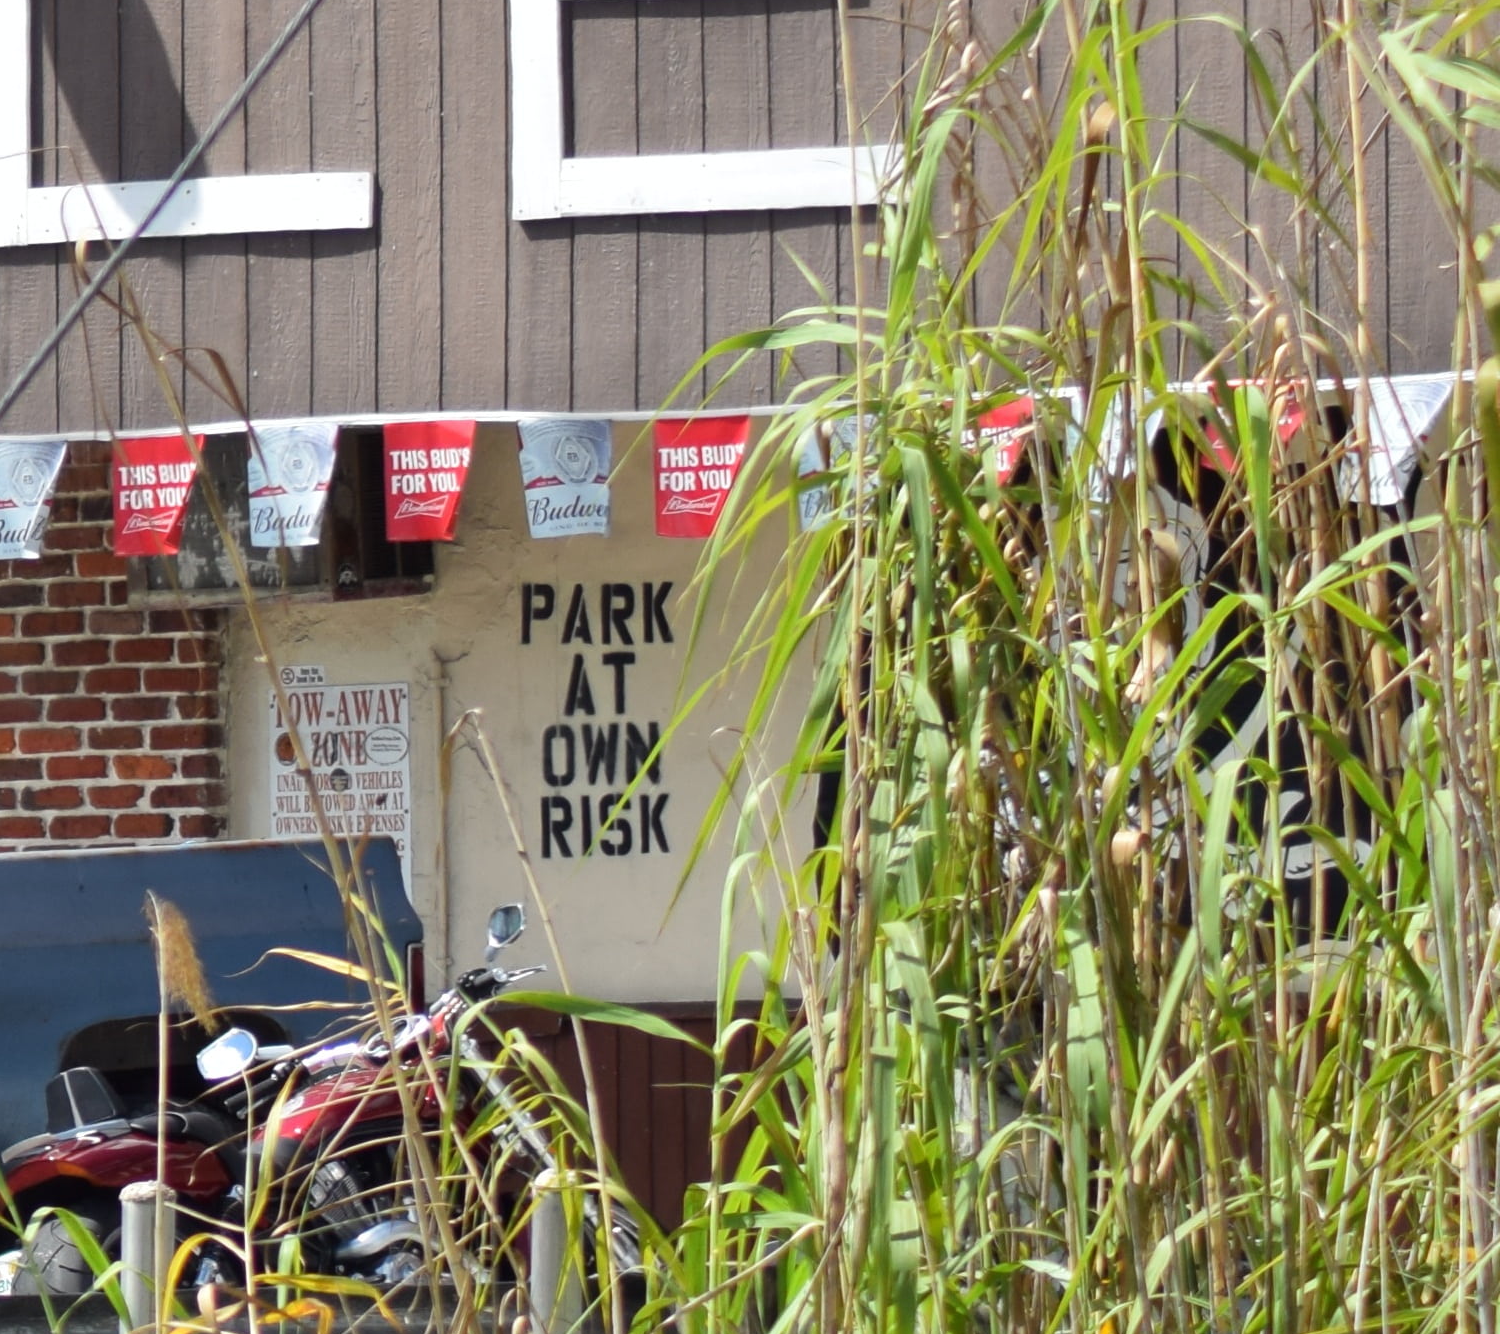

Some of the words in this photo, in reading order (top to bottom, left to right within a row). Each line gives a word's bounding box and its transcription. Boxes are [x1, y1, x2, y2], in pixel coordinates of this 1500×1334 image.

[390, 450, 428, 470] THIS
[430, 448, 470, 468] BUD'S
[658, 446, 699, 468] THIS
[118, 466, 156, 486] THIS
[391, 475, 426, 495] FOR
[428, 472, 460, 492] YOU.
[660, 471, 696, 492] FOR
[119, 490, 155, 510] FOR
[521, 581, 674, 645] PARK
[564, 652, 636, 717] AT
[311, 730, 367, 767] ZONE
[542, 722, 662, 787] OWN
[355, 770, 404, 790] VEHICLES
[276, 795, 301, 813] WILL
[392, 792, 404, 810] AT
[276, 816, 317, 834] OWNERS
[322, 815, 344, 833] ISK
[357, 814, 405, 832] EPENSES
[541, 794, 670, 859] RISK
